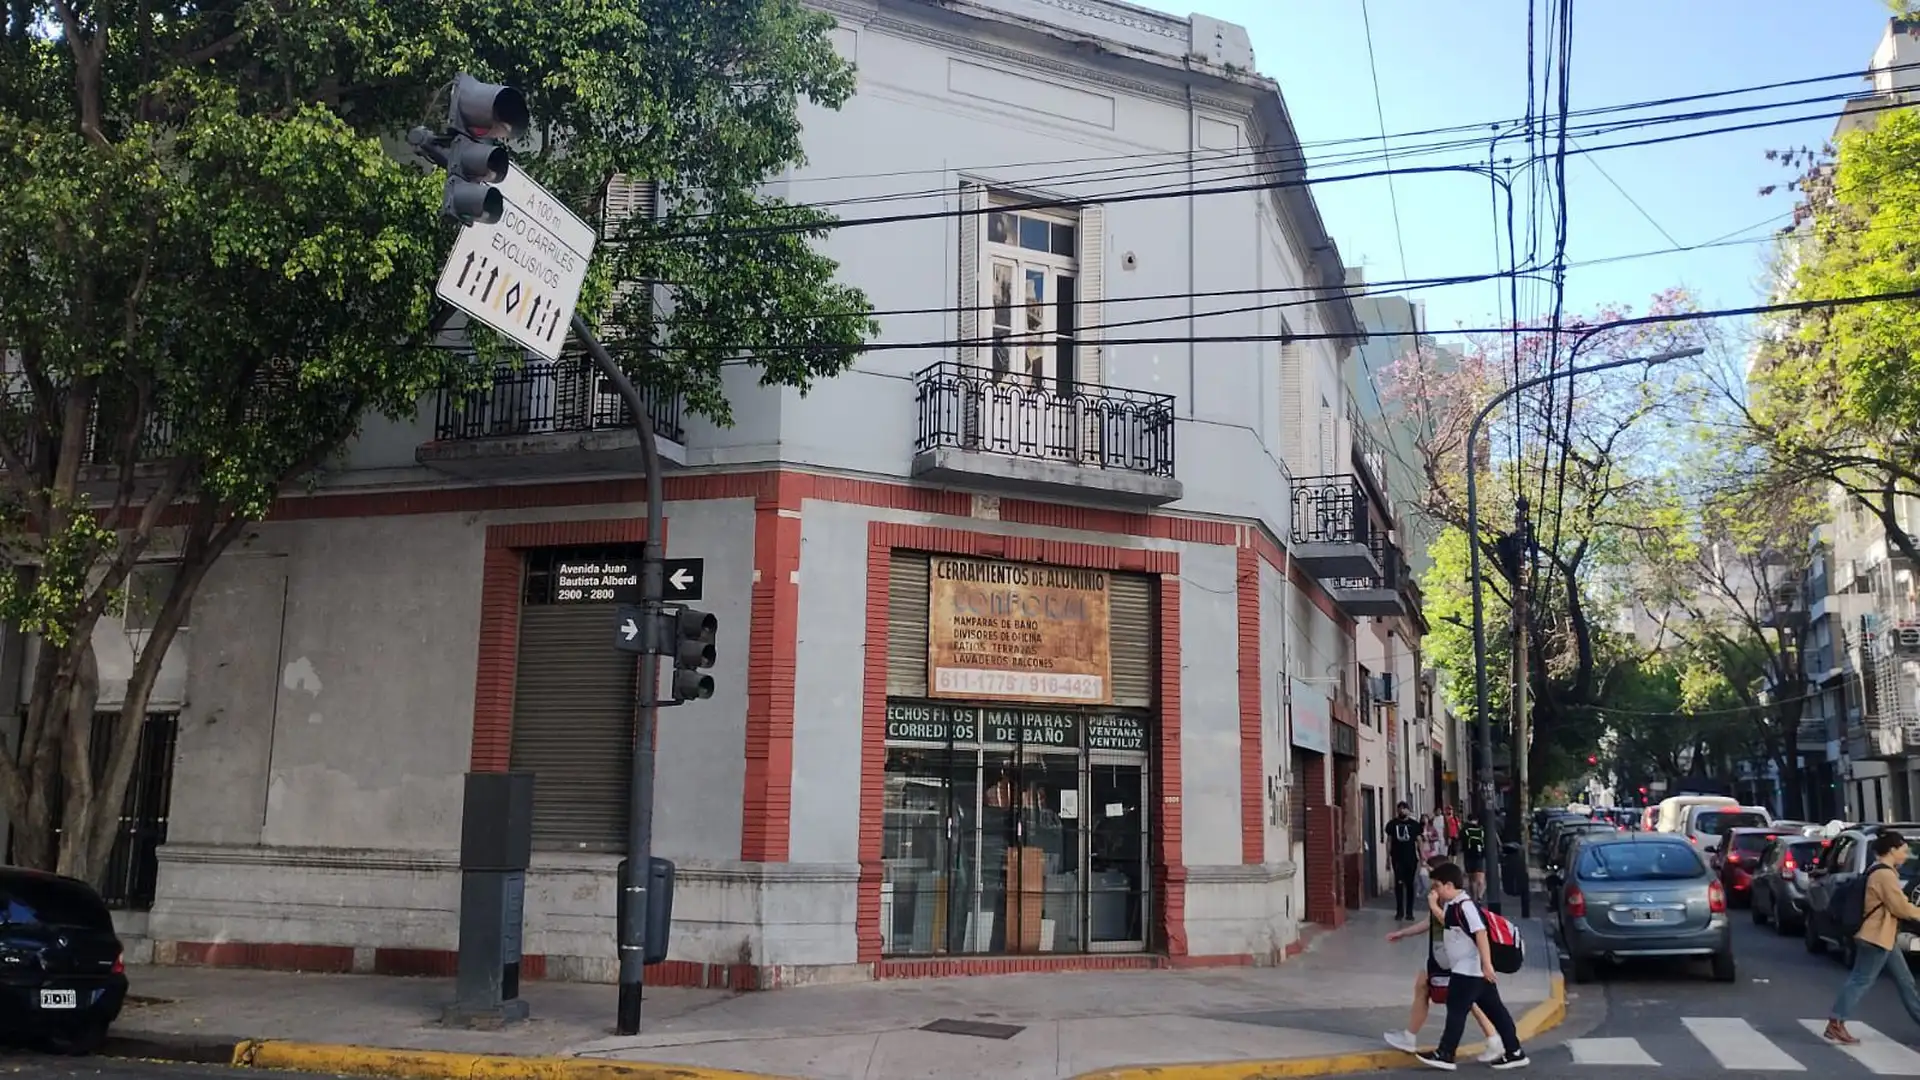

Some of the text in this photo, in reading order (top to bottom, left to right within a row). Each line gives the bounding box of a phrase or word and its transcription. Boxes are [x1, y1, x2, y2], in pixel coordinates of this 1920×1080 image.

[526, 192, 535, 210] A
[536, 200, 553, 221] 100
[501, 208, 575, 273] ICIO CARRILES
[491, 232, 560, 289] EXCLUSIVOS
[560, 563, 627, 574] Avenida Juan
[559, 575, 637, 587] Bautista Alberdi
[936, 560, 1105, 592] CERRAMIENTOS DE ALUMINIO
[558, 590, 582, 600] 2900
[590, 589, 614, 600] 2800
[953, 615, 998, 627] MAMPARAS
[1001, 619, 1013, 629] DE
[953, 629, 998, 641] DIVISORES
[1000, 631, 1010, 642] DE
[953, 654, 1054, 668] LAVADEROS BALCONES
[940, 671, 1016, 691] 611-1775
[887, 706, 930, 721] ECHOS
[988, 711, 1073, 728] MAMPARAS
[1089, 715, 1138, 727] PUERTAS
[996, 727, 1064, 743] DE BAÑO
[1088, 726, 1144, 738] VENTANAS
[1088, 737, 1141, 748] VENTILUZ
